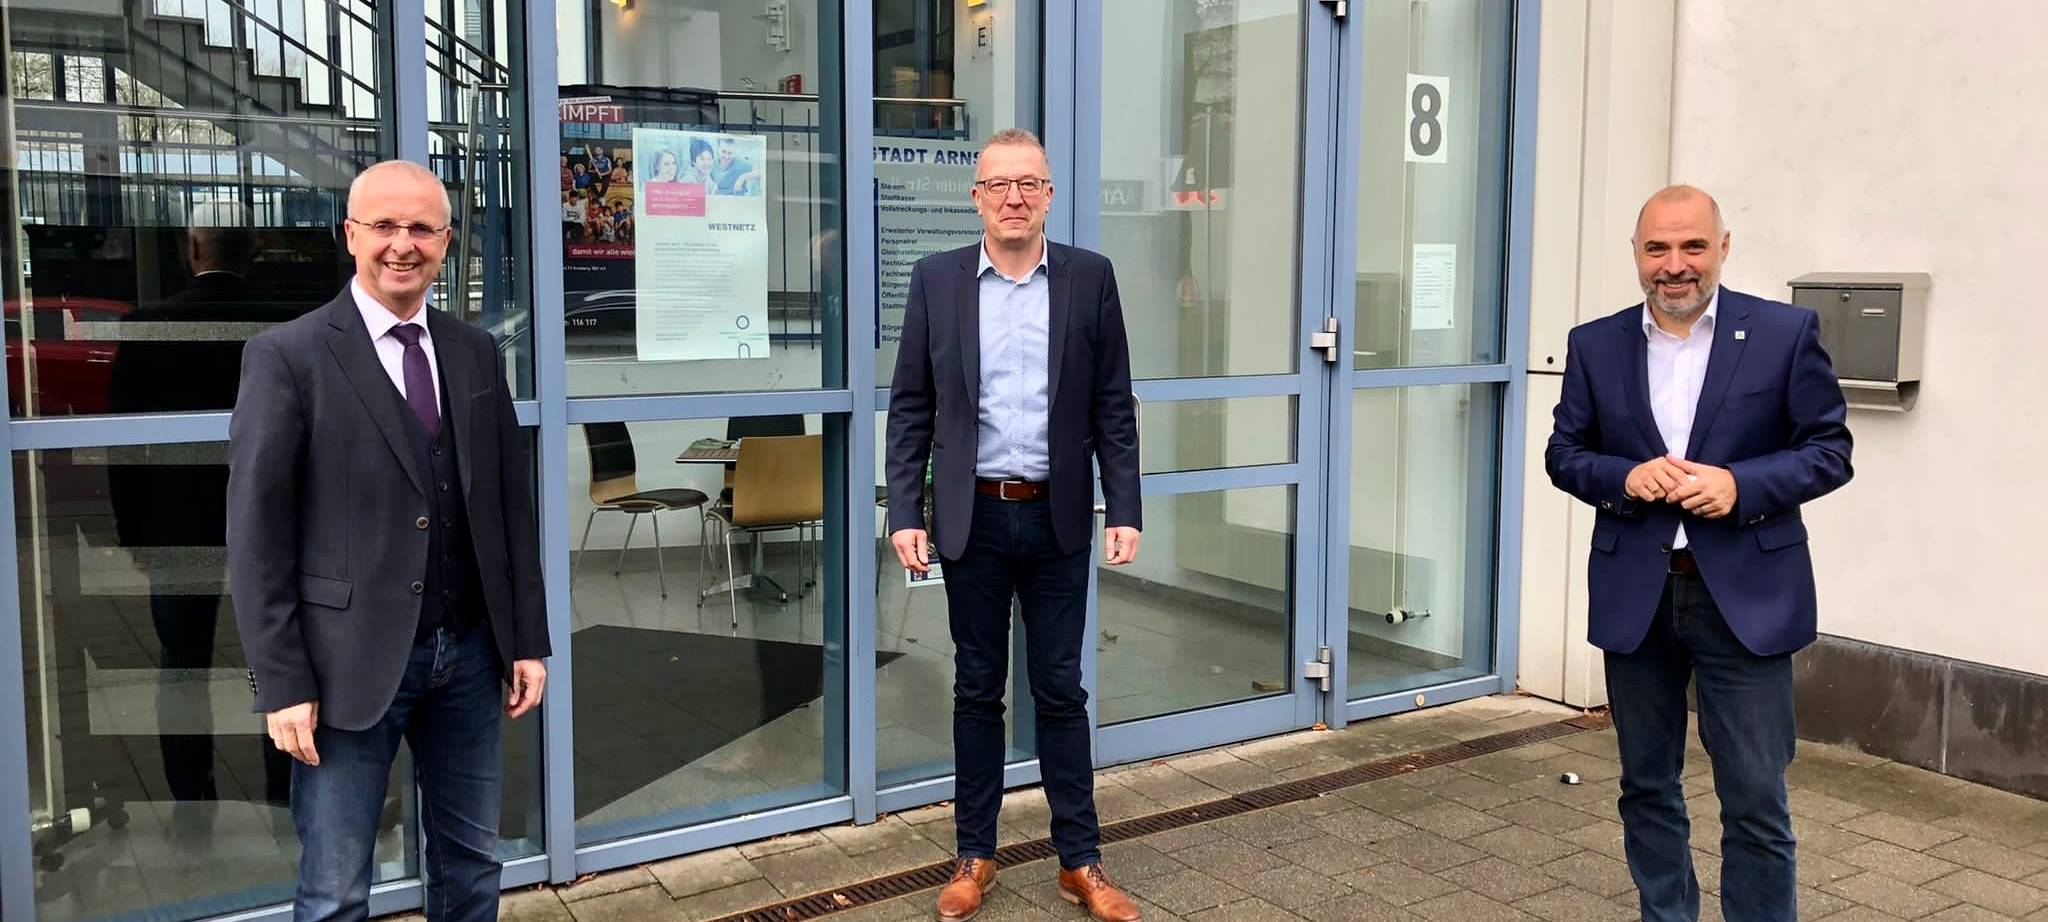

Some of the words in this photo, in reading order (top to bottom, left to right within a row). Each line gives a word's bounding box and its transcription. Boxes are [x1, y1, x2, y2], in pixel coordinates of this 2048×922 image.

[978, 27, 986, 46] E
[559, 104, 622, 121] IMPFT
[1410, 83, 1442, 156] 8
[934, 150, 979, 164] ARNS
[708, 223, 757, 231] WESTNETZ
[572, 248, 593, 256] damit
